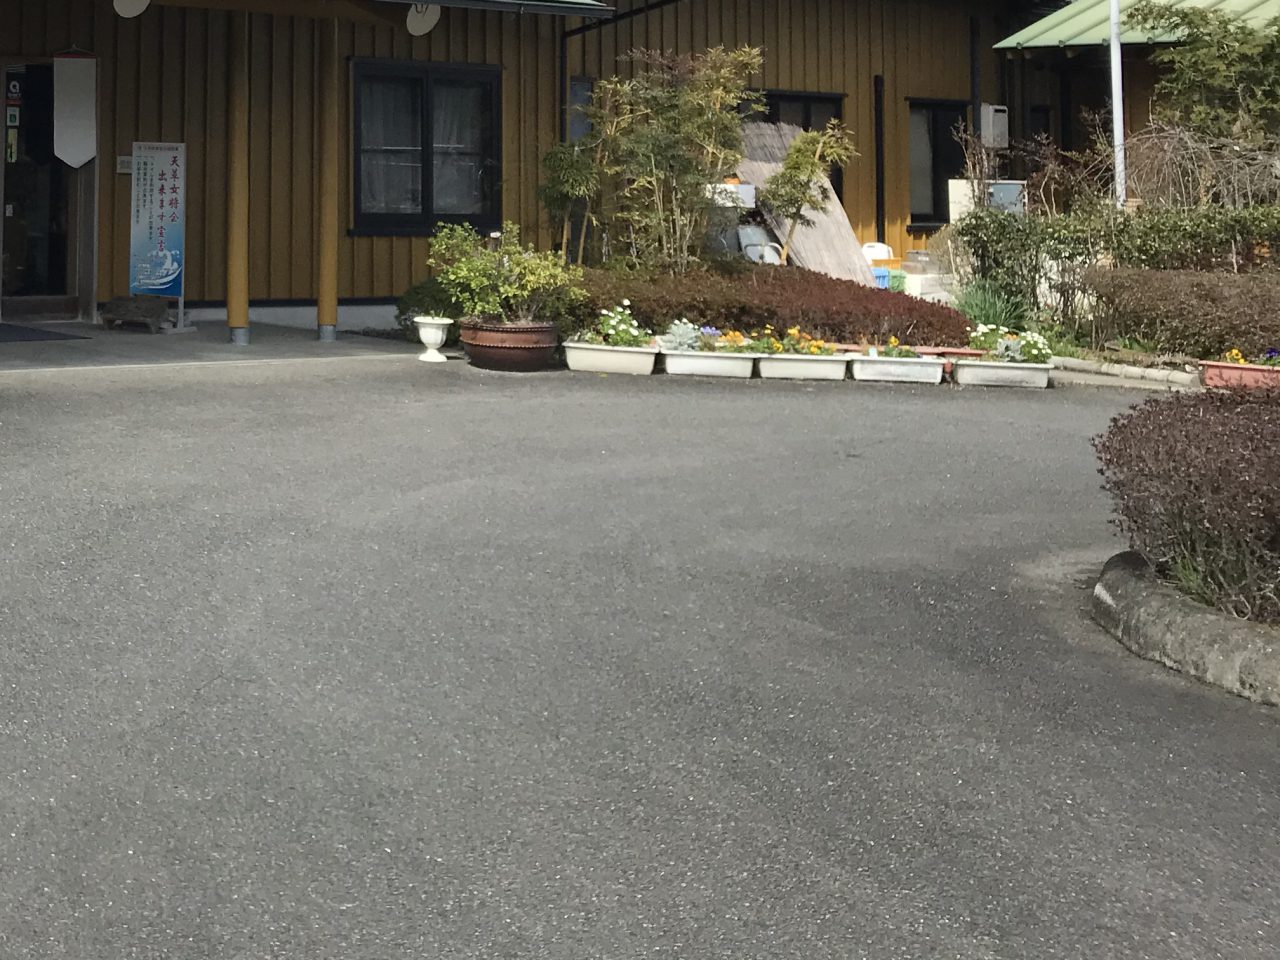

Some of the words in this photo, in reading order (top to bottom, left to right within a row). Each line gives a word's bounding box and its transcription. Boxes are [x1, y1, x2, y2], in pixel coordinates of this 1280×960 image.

[157, 169, 168, 252] 出来ます宣言
[169, 155, 180, 223] 天草女将会
